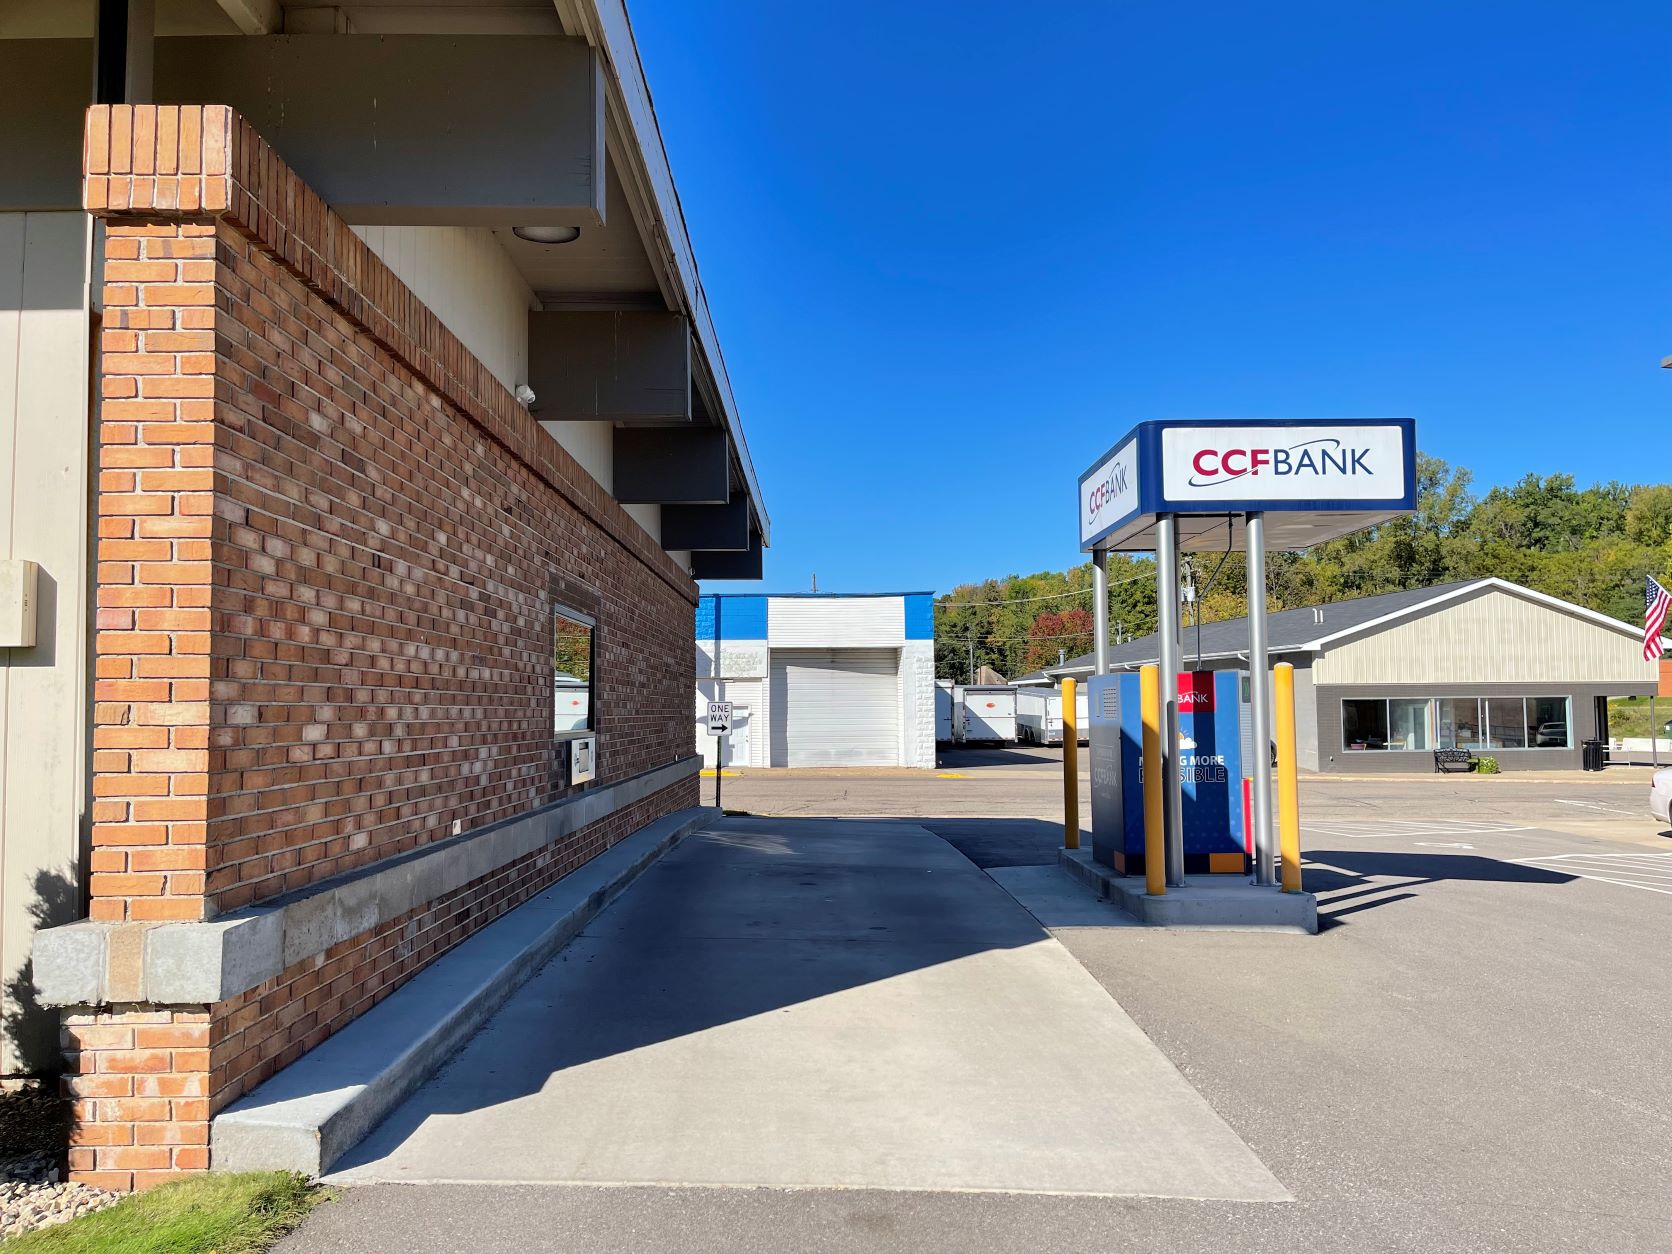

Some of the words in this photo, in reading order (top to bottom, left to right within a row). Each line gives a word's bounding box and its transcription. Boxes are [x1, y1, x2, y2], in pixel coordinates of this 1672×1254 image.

[1190, 446, 1374, 479] CCFBANK
[1089, 465, 1127, 517] CCFBANK
[711, 704, 729, 713] ONE
[711, 714, 729, 722] WAY
[1190, 755, 1225, 766] MORE
